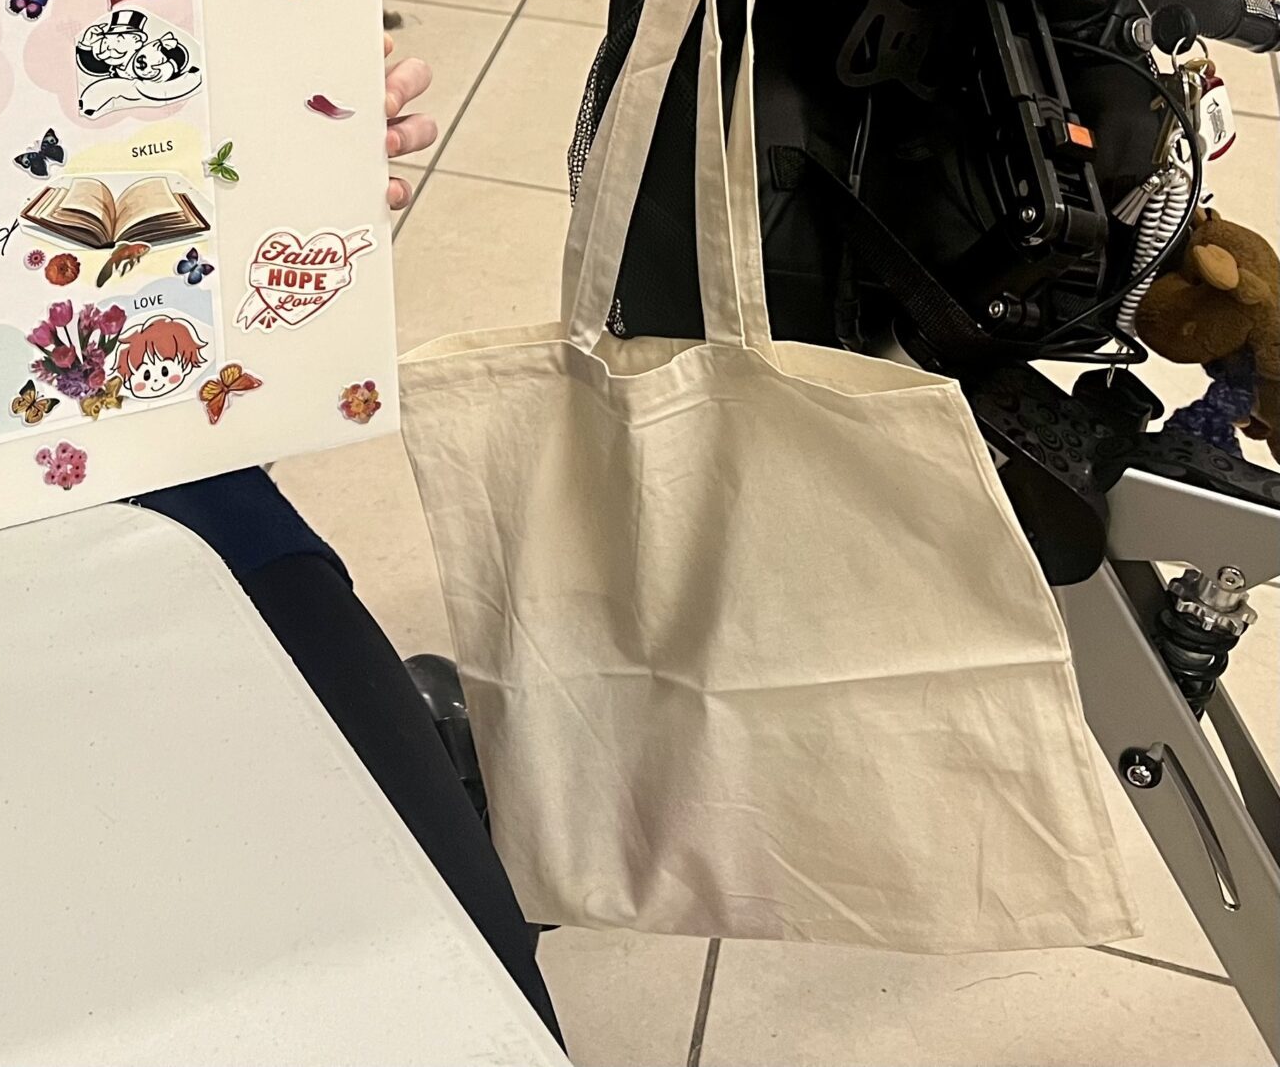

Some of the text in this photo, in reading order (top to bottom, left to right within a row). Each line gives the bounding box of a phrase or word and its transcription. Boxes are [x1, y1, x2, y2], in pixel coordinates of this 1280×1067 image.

[131, 139, 175, 158] SKILLS
[261, 240, 343, 266] Faith
[267, 268, 327, 291] HOPE
[133, 294, 165, 310] LOVE
[274, 294, 323, 312] Love
